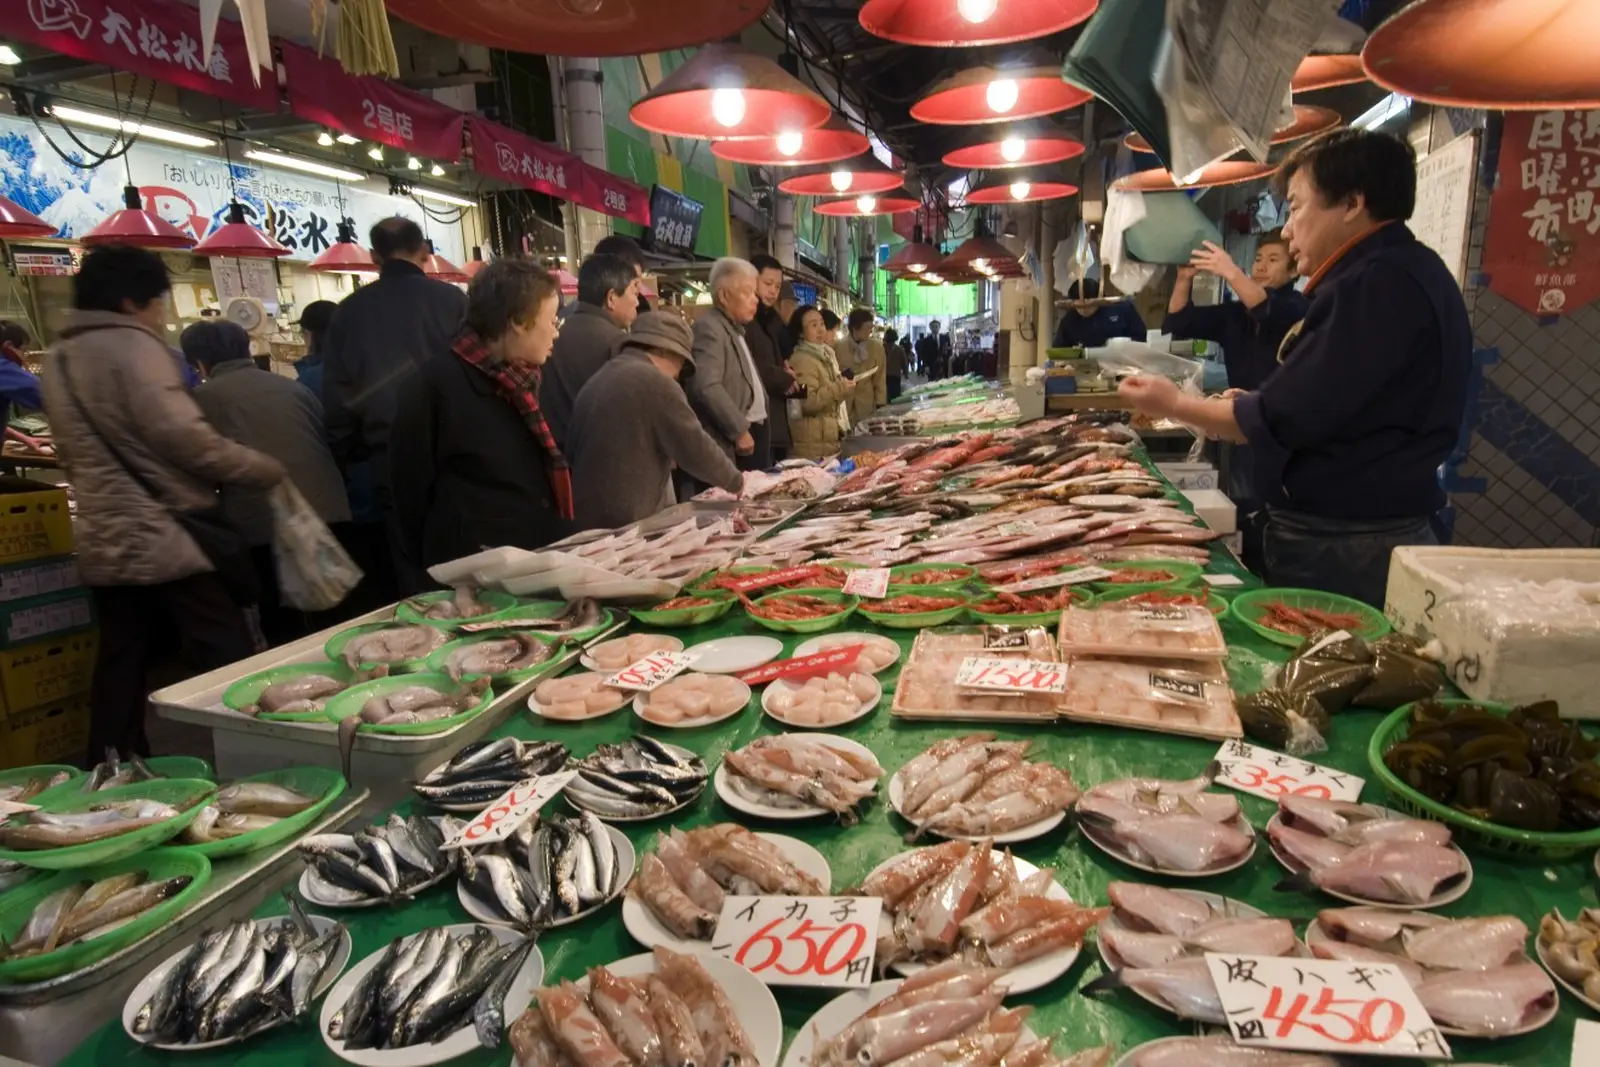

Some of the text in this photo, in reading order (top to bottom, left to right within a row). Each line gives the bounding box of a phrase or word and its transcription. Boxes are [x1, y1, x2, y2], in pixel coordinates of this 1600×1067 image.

[362, 98, 414, 141] 2号店
[604, 188, 627, 212] 2号店
[969, 667, 1061, 689] 1500
[733, 917, 867, 976] 650
[1262, 986, 1406, 1045] 450
